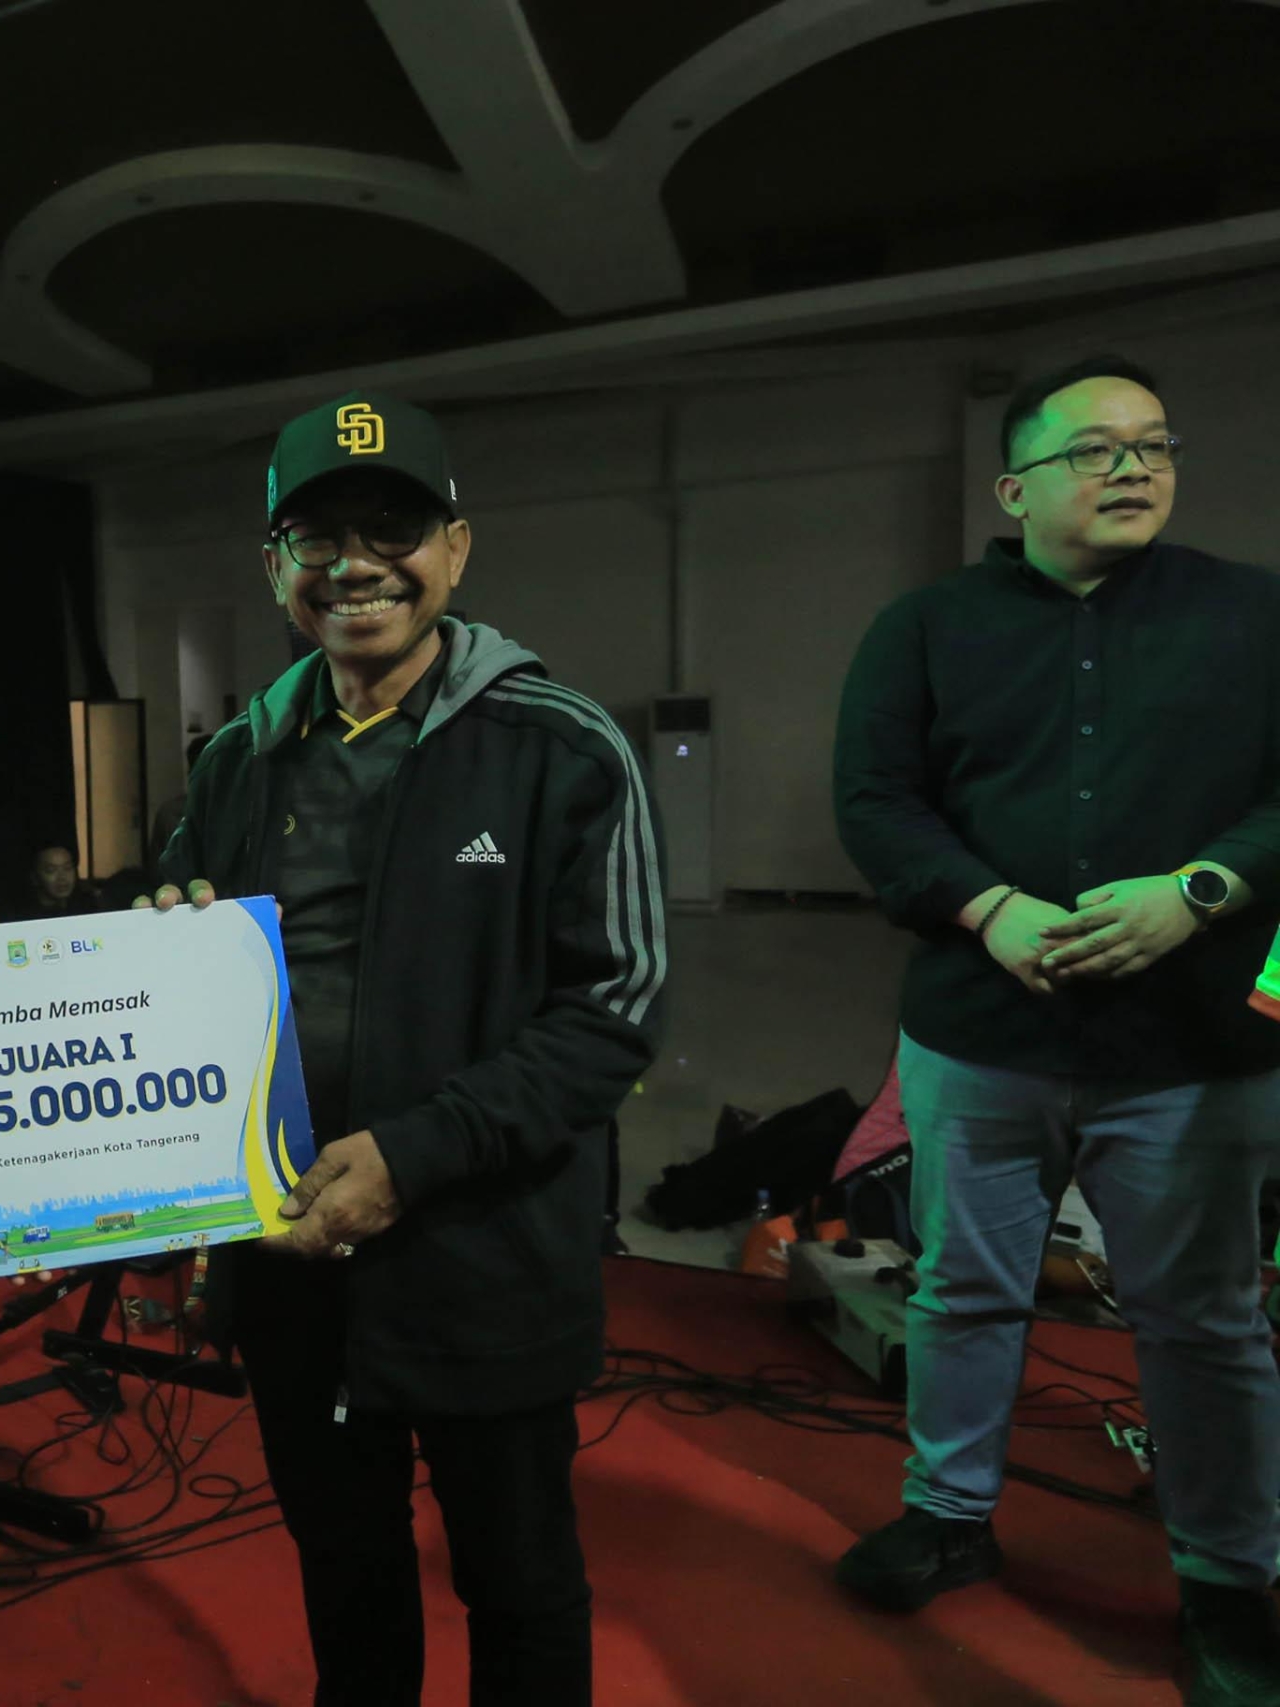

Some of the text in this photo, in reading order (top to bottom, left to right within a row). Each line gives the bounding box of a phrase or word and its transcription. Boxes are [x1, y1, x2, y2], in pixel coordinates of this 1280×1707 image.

[336, 402, 385, 455] SD
[456, 851, 506, 864] adidas
[71, 938, 104, 953] BLK
[49, 990, 151, 1019] Memasak
[119, 1032, 136, 1061] I
[104, 1140, 132, 1154] Kota
[136, 1132, 200, 1149] Tangerang
